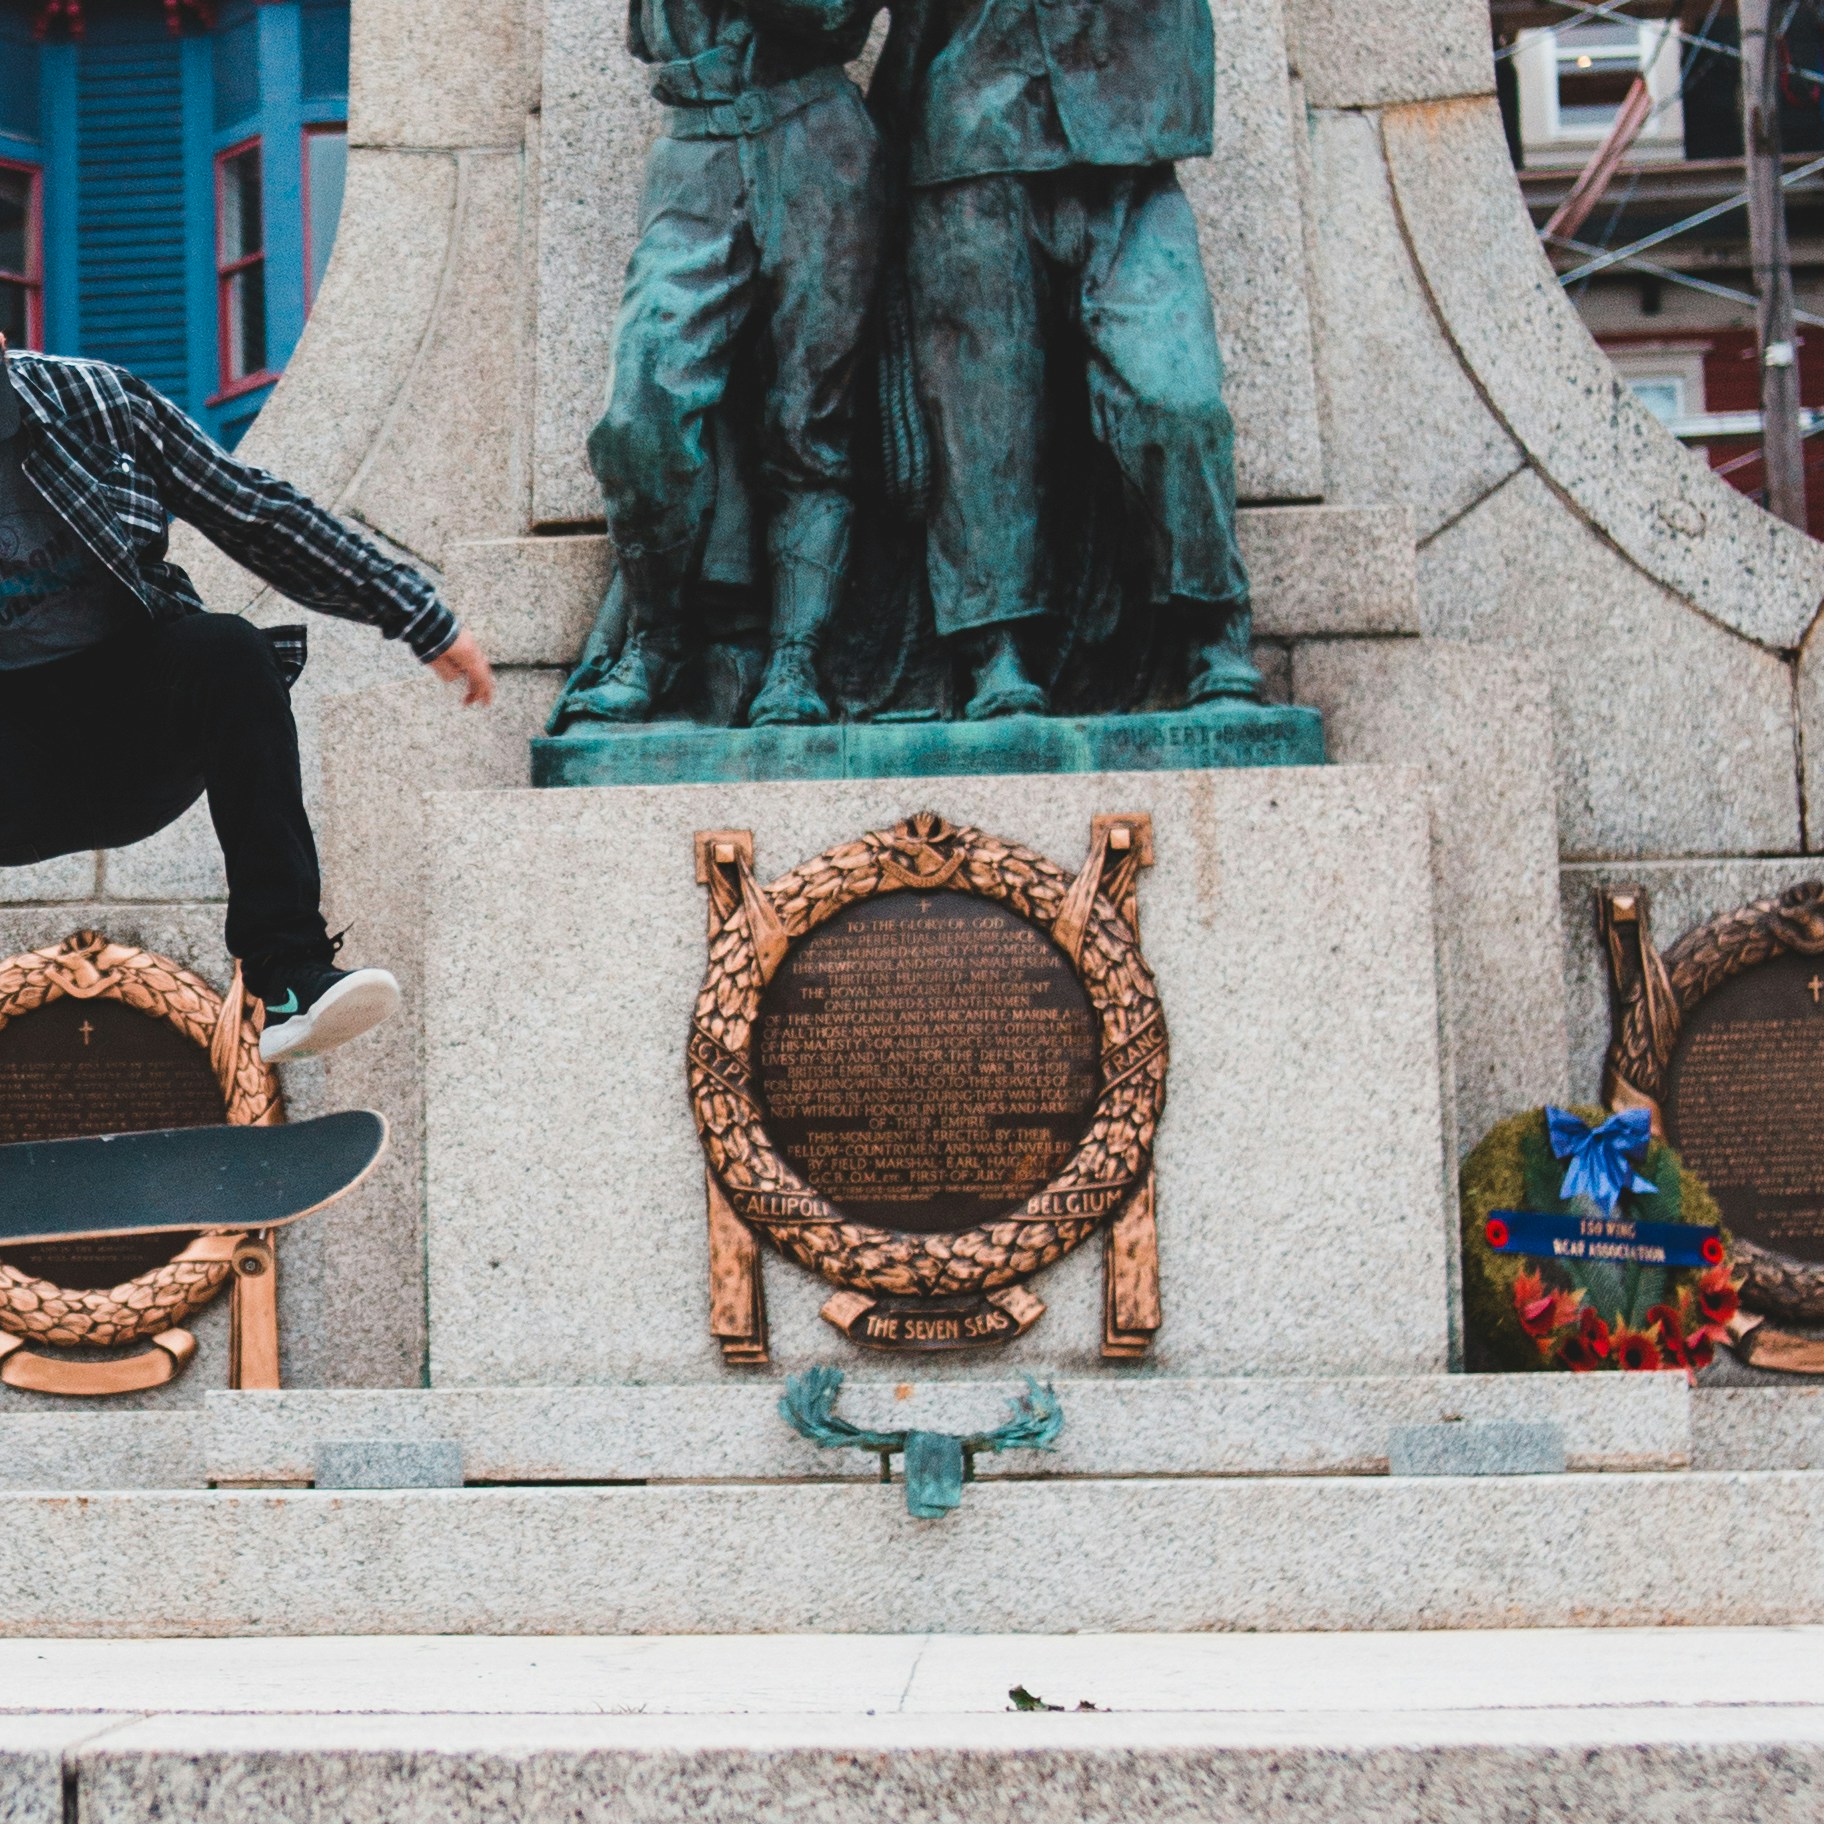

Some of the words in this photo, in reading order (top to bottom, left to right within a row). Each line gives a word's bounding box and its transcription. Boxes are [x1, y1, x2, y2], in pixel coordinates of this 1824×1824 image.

[848, 921, 865, 932] TO
[873, 920, 895, 931] THE
[900, 919, 944, 931] GLORY
[972, 918, 1004, 929] GOD
[858, 933, 930, 945] PERPETUAL
[937, 930, 1035, 943] REMEMBRANCE
[846, 947, 908, 959] HUNDRED
[792, 964, 813, 975] THE
[818, 960, 924, 973] NEWFOUNDLAND
[828, 974, 890, 986] THIRTEEN
[896, 972, 963, 984] HUNDRED
[970, 970, 1000, 981] MEN
[800, 987, 825, 999] THE
[830, 986, 872, 998] ROYAL
[875, 983, 983, 996] NEWFOUNDLAND
[985, 981, 1052, 994] REGIMENT
[824, 1001, 851, 1012] ONE
[854, 999, 915, 1011] HUNDRED
[787, 1014, 811, 1026] THE
[815, 1011, 926, 1025] NEWFOUNDLAND
[929, 1009, 1008, 1022] MERCANTILE
[782, 1027, 805, 1039] ALL
[808, 1025, 849, 1038] THOSE
[853, 1023, 983, 1037] NEWFOUNDLANDERS
[780, 1039, 801, 1052] HIS
[897, 1036, 940, 1049] ALLIED
[995, 1035, 1025, 1047] WHO
[689, 1033, 751, 1087] EGYPT
[762, 1054, 796, 1066] LIVES
[820, 1052, 845, 1064] SEA
[848, 1052, 876, 1063] AND
[880, 1051, 914, 1063] LAND
[918, 1050, 943, 1062] FOR
[949, 1049, 973, 1061] THE
[980, 1049, 1038, 1061] DEFENCE
[787, 1066, 834, 1078] BRITISH
[839, 1065, 882, 1077] EMPIRE
[905, 1063, 928, 1075] THE
[932, 1062, 973, 1075] GREAT
[791, 1079, 855, 1091] ENDURING
[969, 1076, 992, 1088] THE
[816, 1091, 842, 1103] THIS
[845, 1090, 890, 1103] ISLAND
[976, 1089, 1006, 1101] THAT
[770, 1105, 797, 1118] NOT
[800, 1104, 861, 1117] WITHOUT
[1008, 1102, 1036, 1114] AND
[869, 1117, 888, 1130] OF
[807, 1131, 835, 1144] THIS
[838, 1130, 910, 1143] MONUMENT
[932, 1129, 991, 1142] ERECTED
[994, 1128, 1012, 1141] BY
[1017, 1127, 1051, 1140] THEIR
[944, 1142, 972, 1155] AND
[975, 1142, 1004, 1154] WAS
[1008, 1141, 1073, 1154] UNVEILED
[807, 1158, 825, 1171] BY
[830, 1157, 868, 1171] FIELD
[875, 1156, 939, 1170] MARSHAL
[945, 1156, 981, 1169] EARL
[909, 1169, 945, 1182] FIRST
[949, 1169, 970, 1182] OF
[974, 1168, 1006, 1182] JULY
[733, 1193, 831, 1218] GALLIPOLI
[1027, 1188, 1124, 1215] BELGIUM
[866, 1314, 900, 1340] THE
[904, 1319, 960, 1340] SEVEN
[964, 1309, 1011, 1338] SEAS
